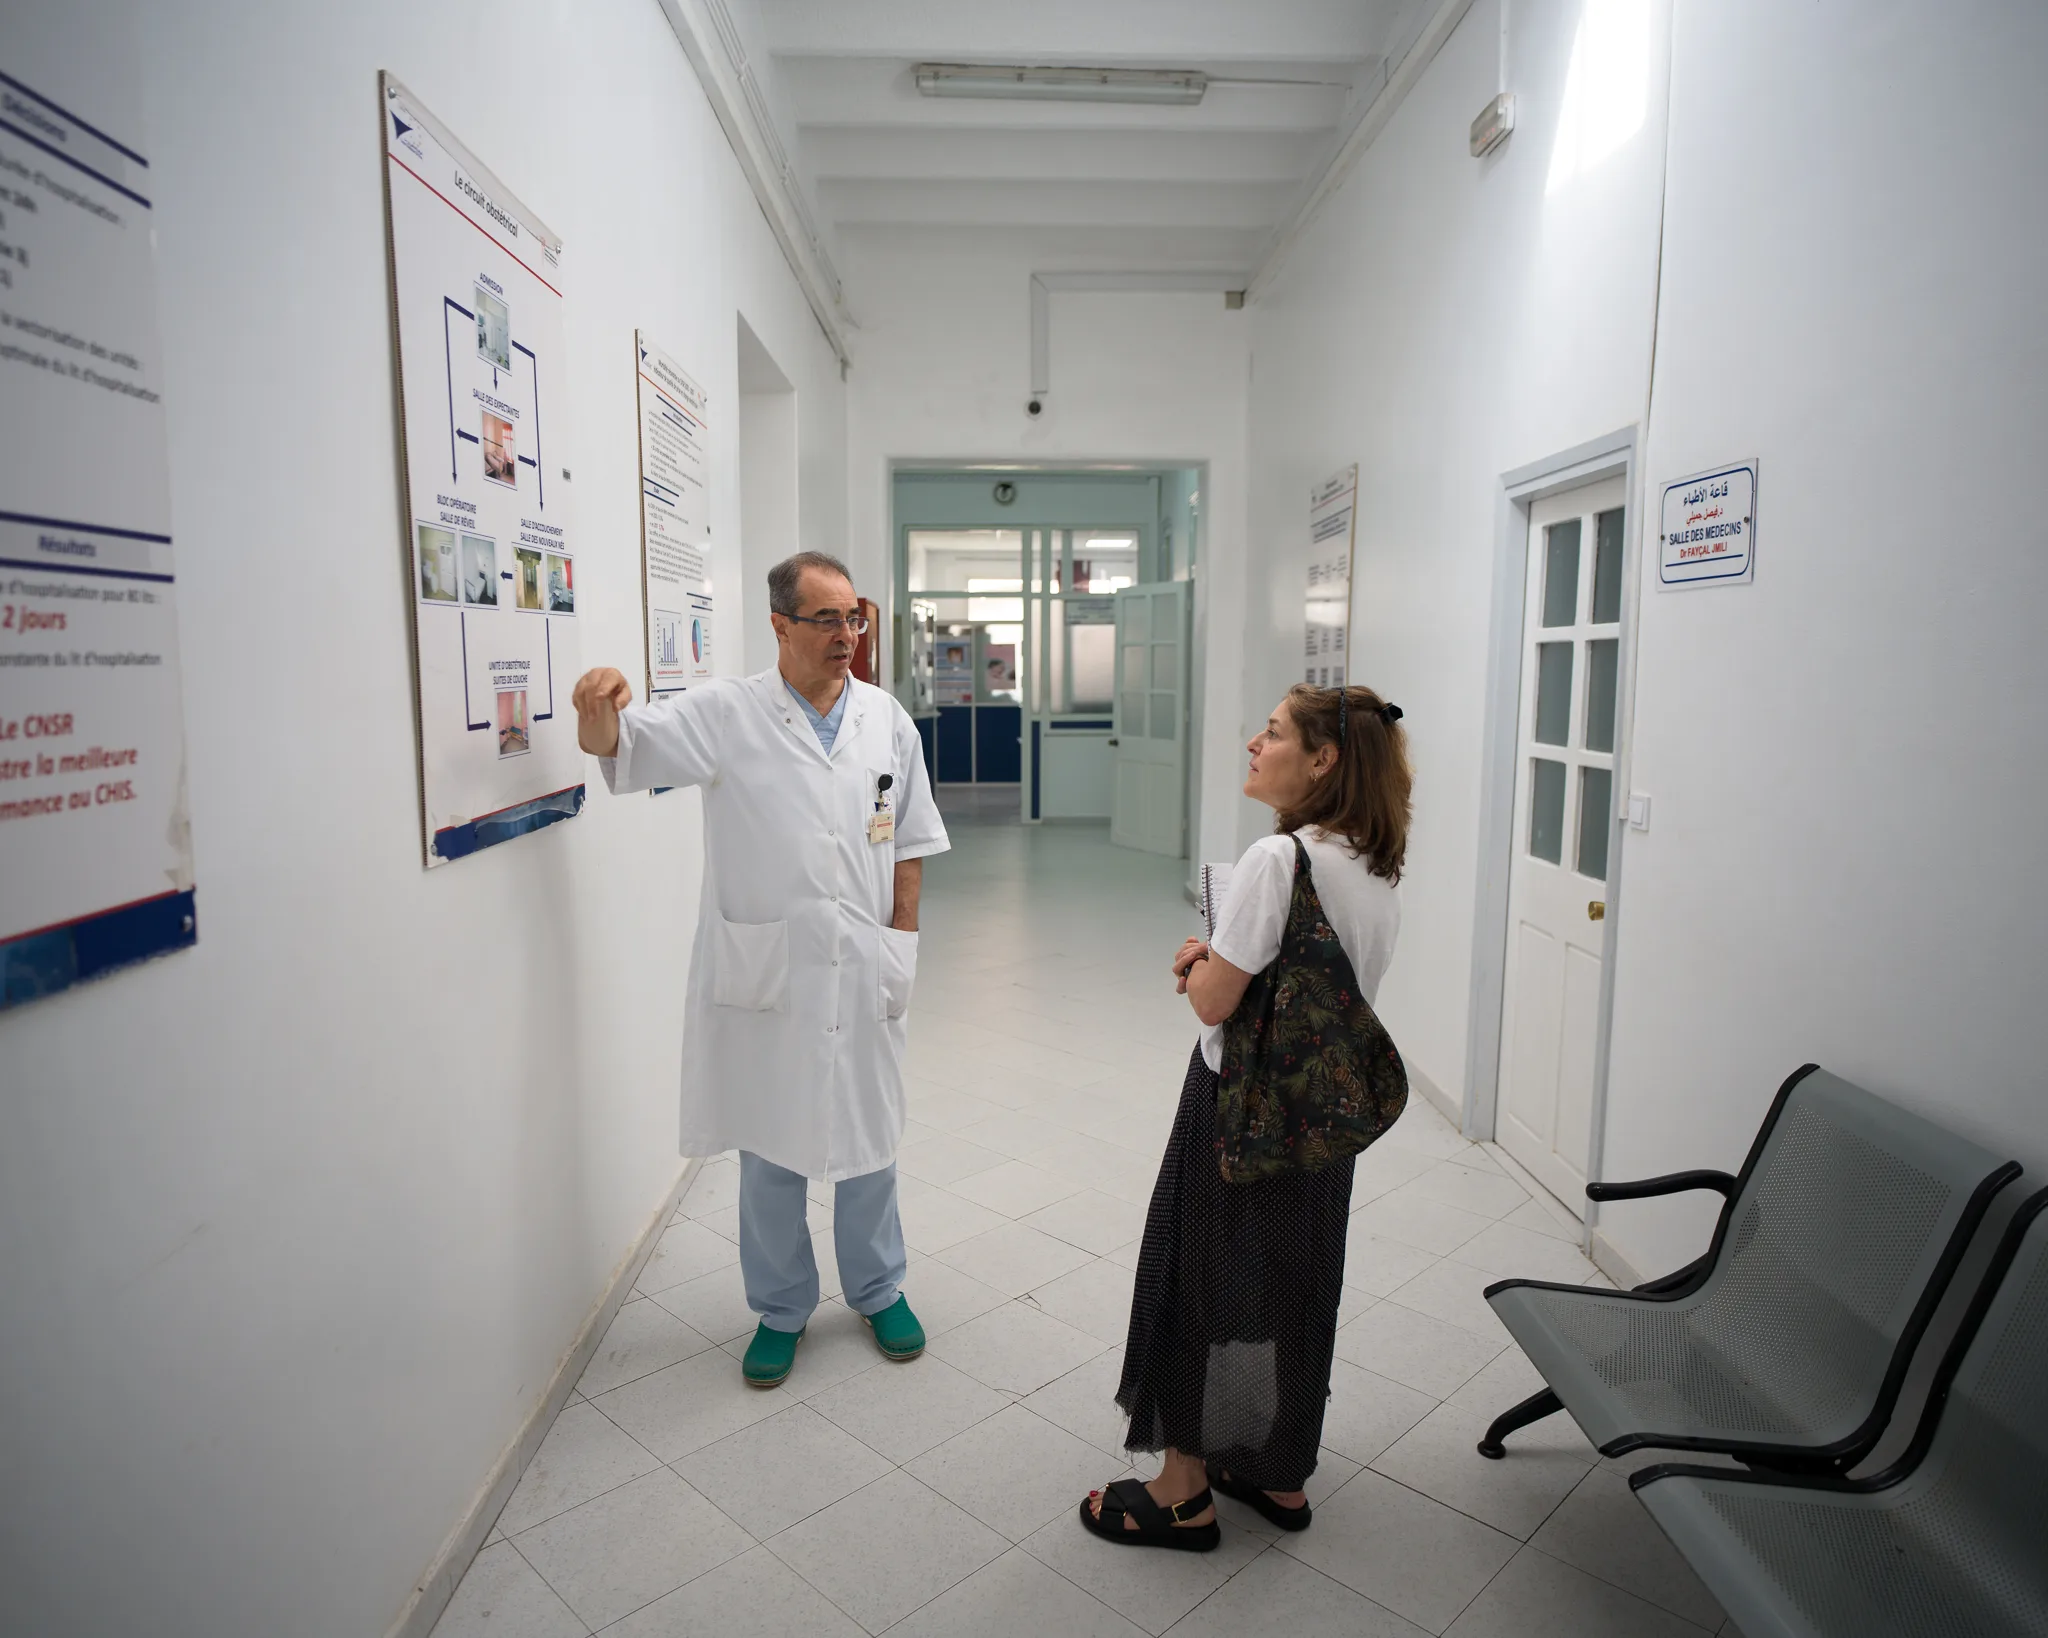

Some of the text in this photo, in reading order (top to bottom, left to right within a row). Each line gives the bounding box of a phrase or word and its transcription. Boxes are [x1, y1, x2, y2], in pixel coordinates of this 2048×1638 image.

[455, 170, 518, 238] Le circuit obstétrical
[480, 272, 503, 295] ADMISSION
[473, 388, 520, 419] SALLE DES EXPECTANTES
[437, 494, 476, 514] BLOC OPÉRATOIRE
[1683, 481, 1728, 507] قاعة الأطباء
[440, 511, 476, 529] SALLE DE RÉVEIL
[521, 518, 563, 536] SALLE D'ACCOUCHEMENT
[521, 532, 531, 542] SALLE
[539, 536, 557, 548] NOUVEAUX
[1669, 521, 1742, 546] SALLE DES MEDECINS
[38, 535, 96, 557] Résultats
[1680, 541, 1728, 558] Dr FAYÇAL JMILI
[3, 604, 67, 635] 2 jours
[489, 659, 531, 670] UNITÉ D'OBSTÉTRIQUE
[493, 674, 528, 685] SUITES DE COUCHE
[24, 714, 74, 739] CNSR
[37, 752, 54, 775] la
[60, 746, 137, 774] meilleure
[69, 789, 91, 811] au
[96, 779, 137, 806] CHIS.
